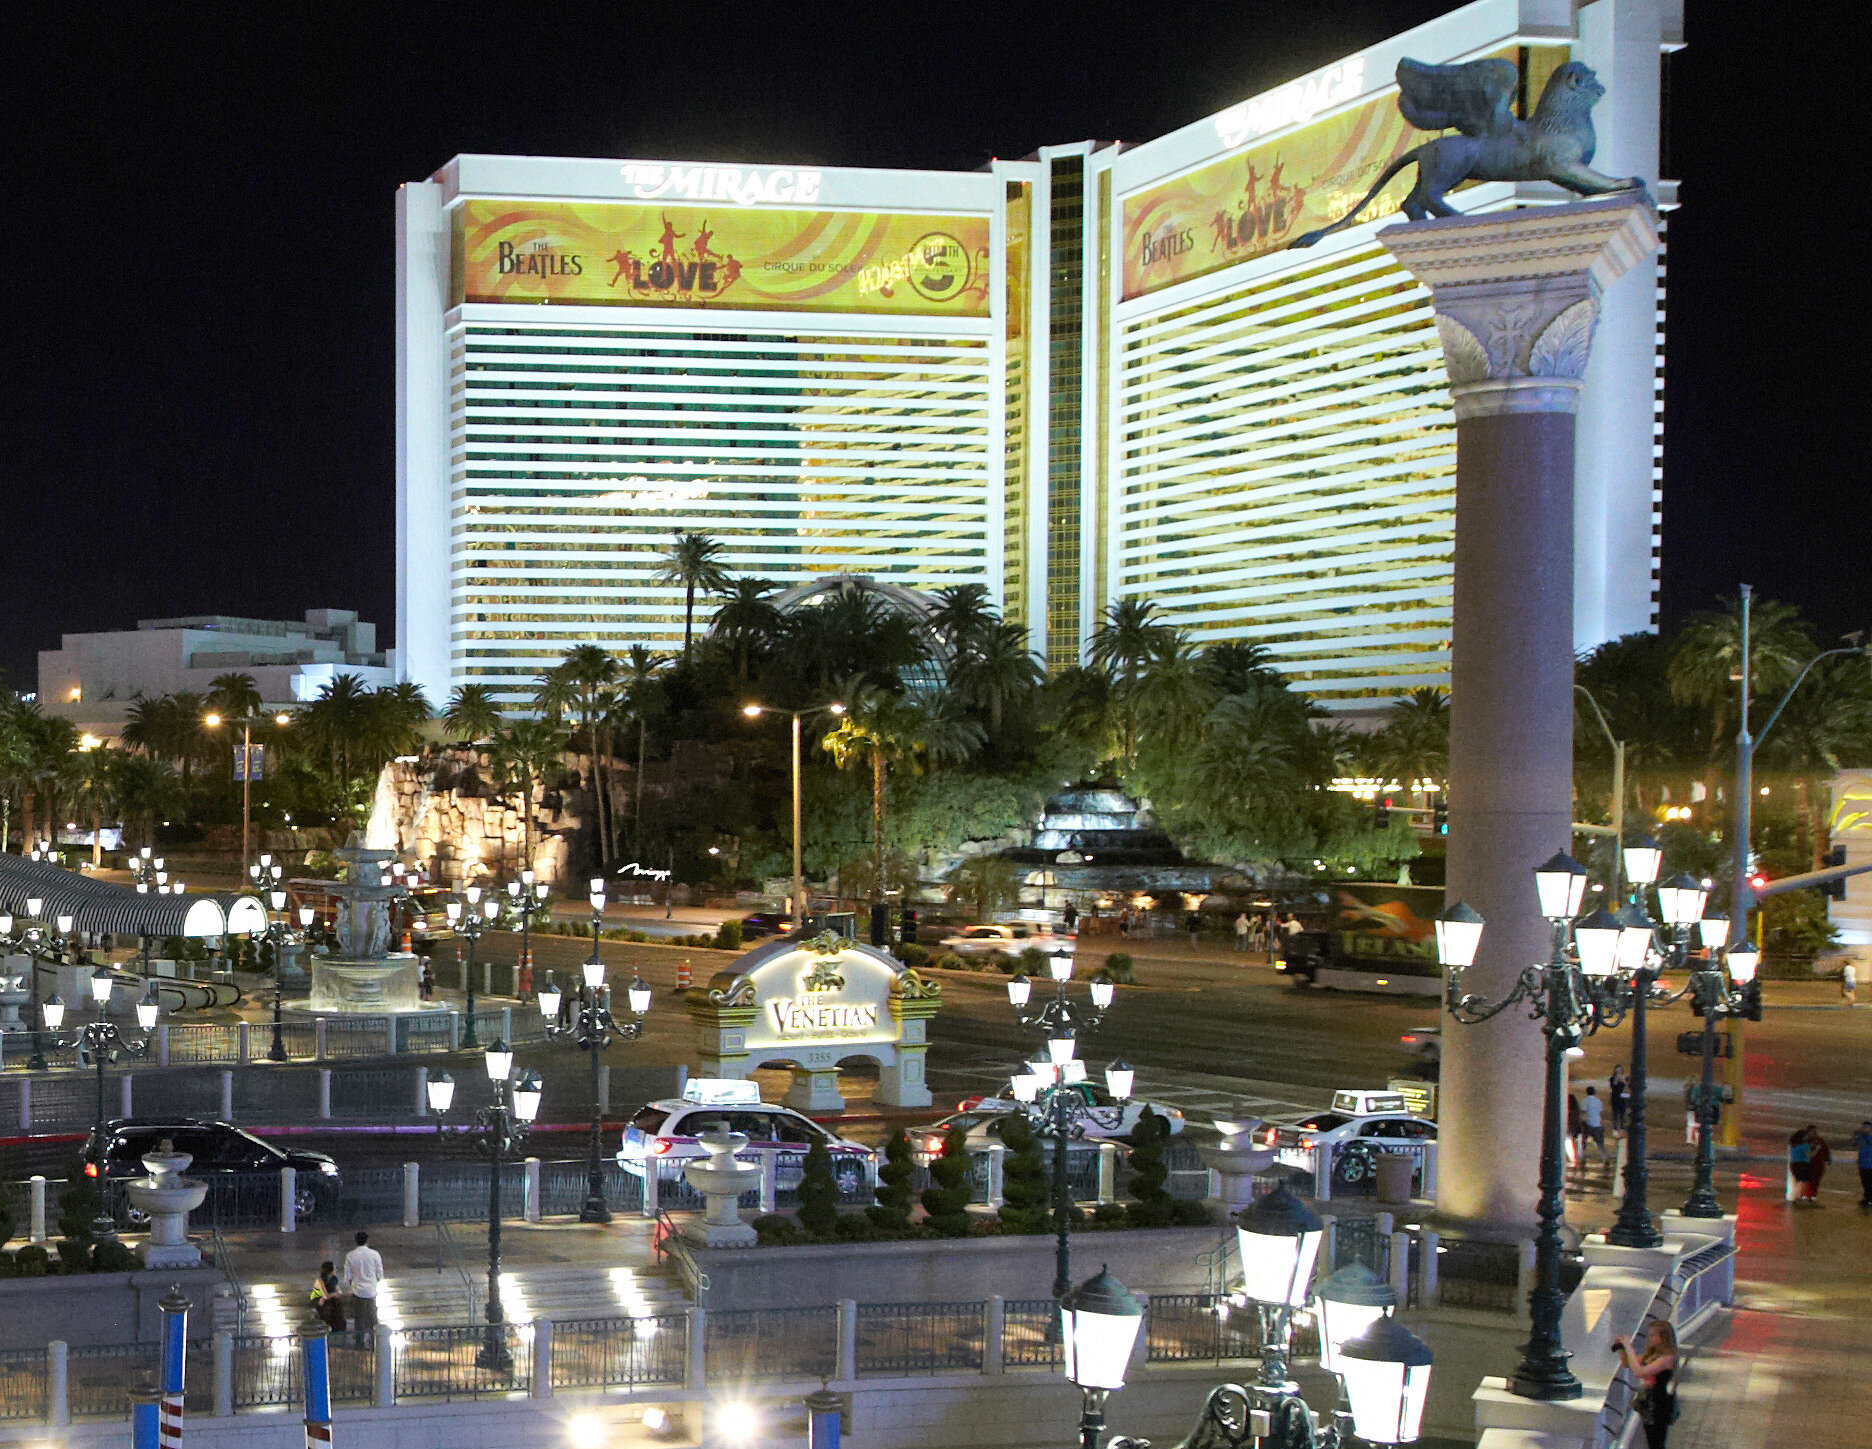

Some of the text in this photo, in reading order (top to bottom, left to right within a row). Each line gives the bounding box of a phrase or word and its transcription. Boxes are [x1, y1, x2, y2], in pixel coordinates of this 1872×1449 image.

[634, 166, 821, 205] MIRAGE
[499, 241, 582, 279] BEATLES
[533, 242, 548, 252] THE
[1142, 228, 1194, 266] BEATLES
[633, 260, 716, 292] LOVE
[763, 261, 804, 273] CIRQUE
[809, 263, 825, 272] DU
[773, 1000, 878, 1032] VENETIAN
[801, 995, 824, 1005] THE
